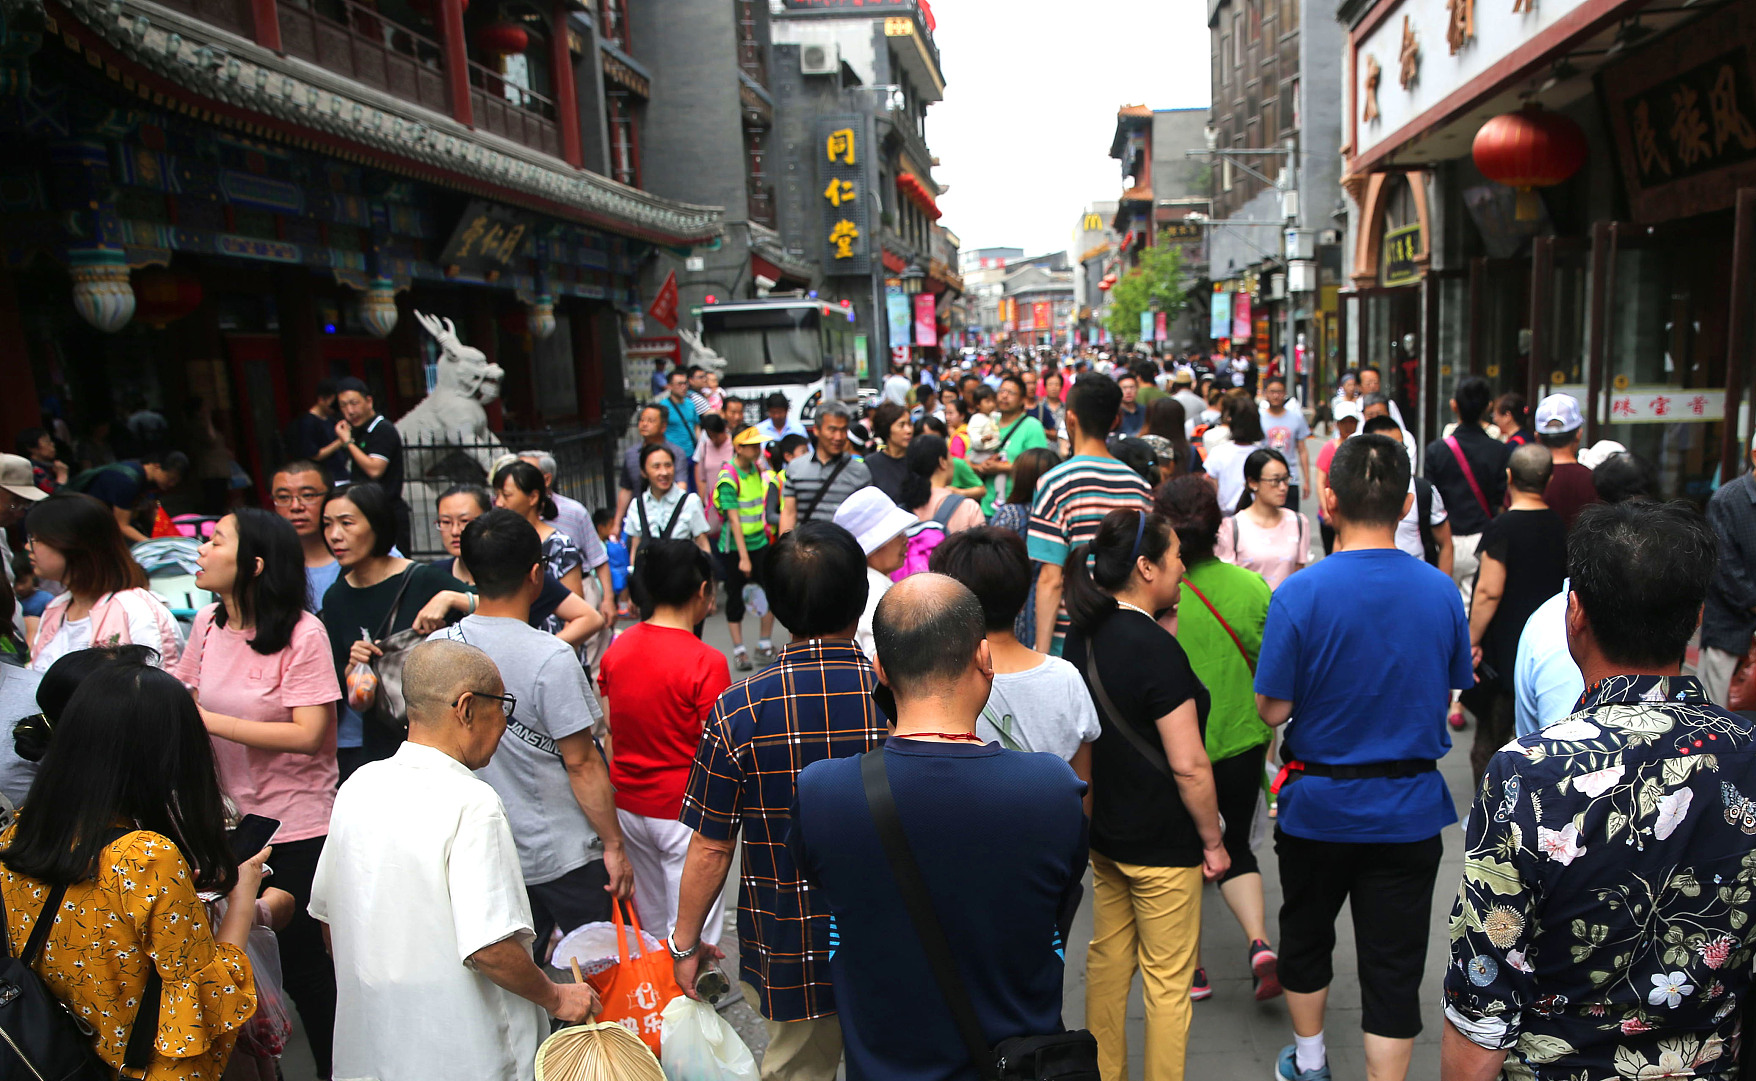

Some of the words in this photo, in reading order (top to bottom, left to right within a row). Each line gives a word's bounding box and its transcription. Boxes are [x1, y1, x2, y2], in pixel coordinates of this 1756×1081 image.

[825, 128, 859, 260] 同仁堂
[1612, 395, 1725, 417] 珠宝首
[507, 721, 562, 756] JANSYAN
